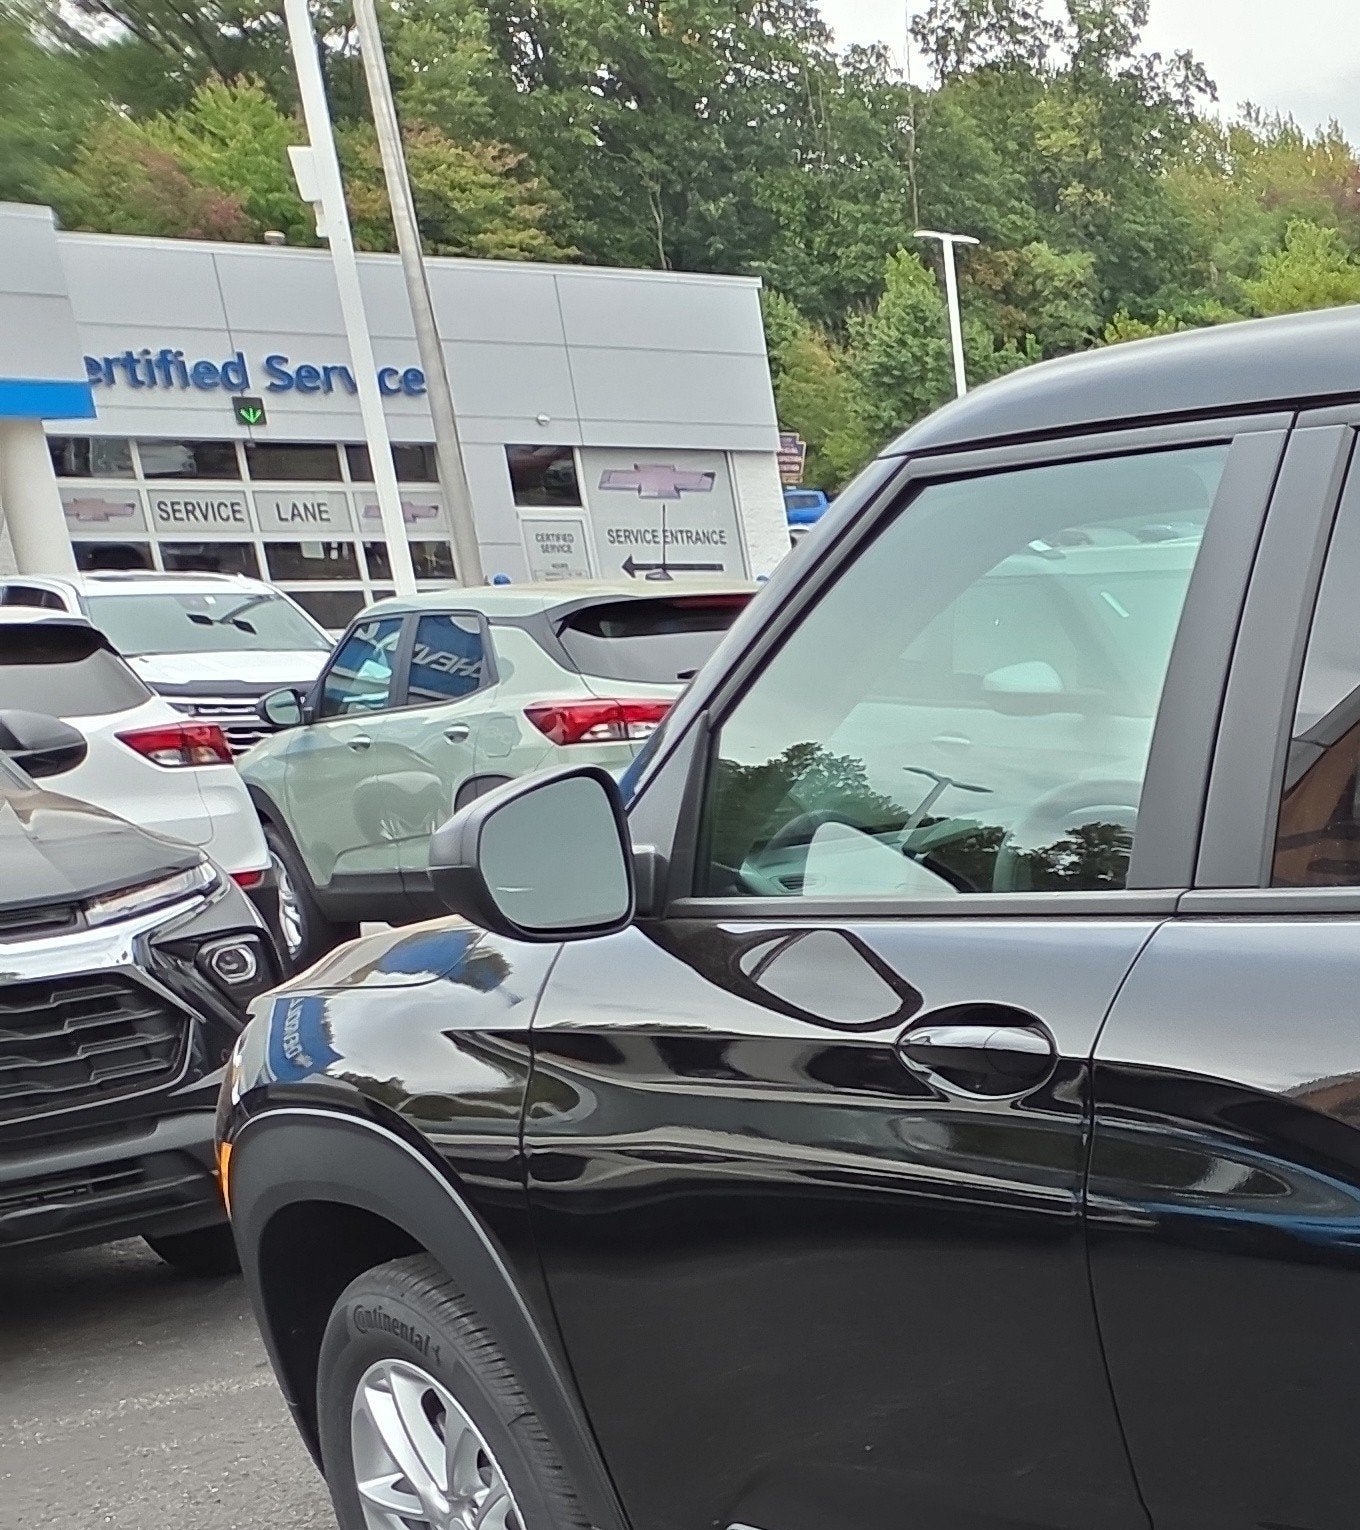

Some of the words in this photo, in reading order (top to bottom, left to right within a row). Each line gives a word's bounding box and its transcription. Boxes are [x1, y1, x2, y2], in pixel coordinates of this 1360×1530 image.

[84, 349, 251, 392] ertified
[264, 354, 427, 394] Servce
[156, 500, 245, 523] SERVICE
[275, 501, 331, 523] LANE
[535, 532, 574, 543] CERTIFIED
[607, 528, 660, 545] SERVICE
[662, 529, 728, 546] ENTRANCE
[540, 544, 573, 554] SERVICE
[352, 1303, 432, 1358] Continental
